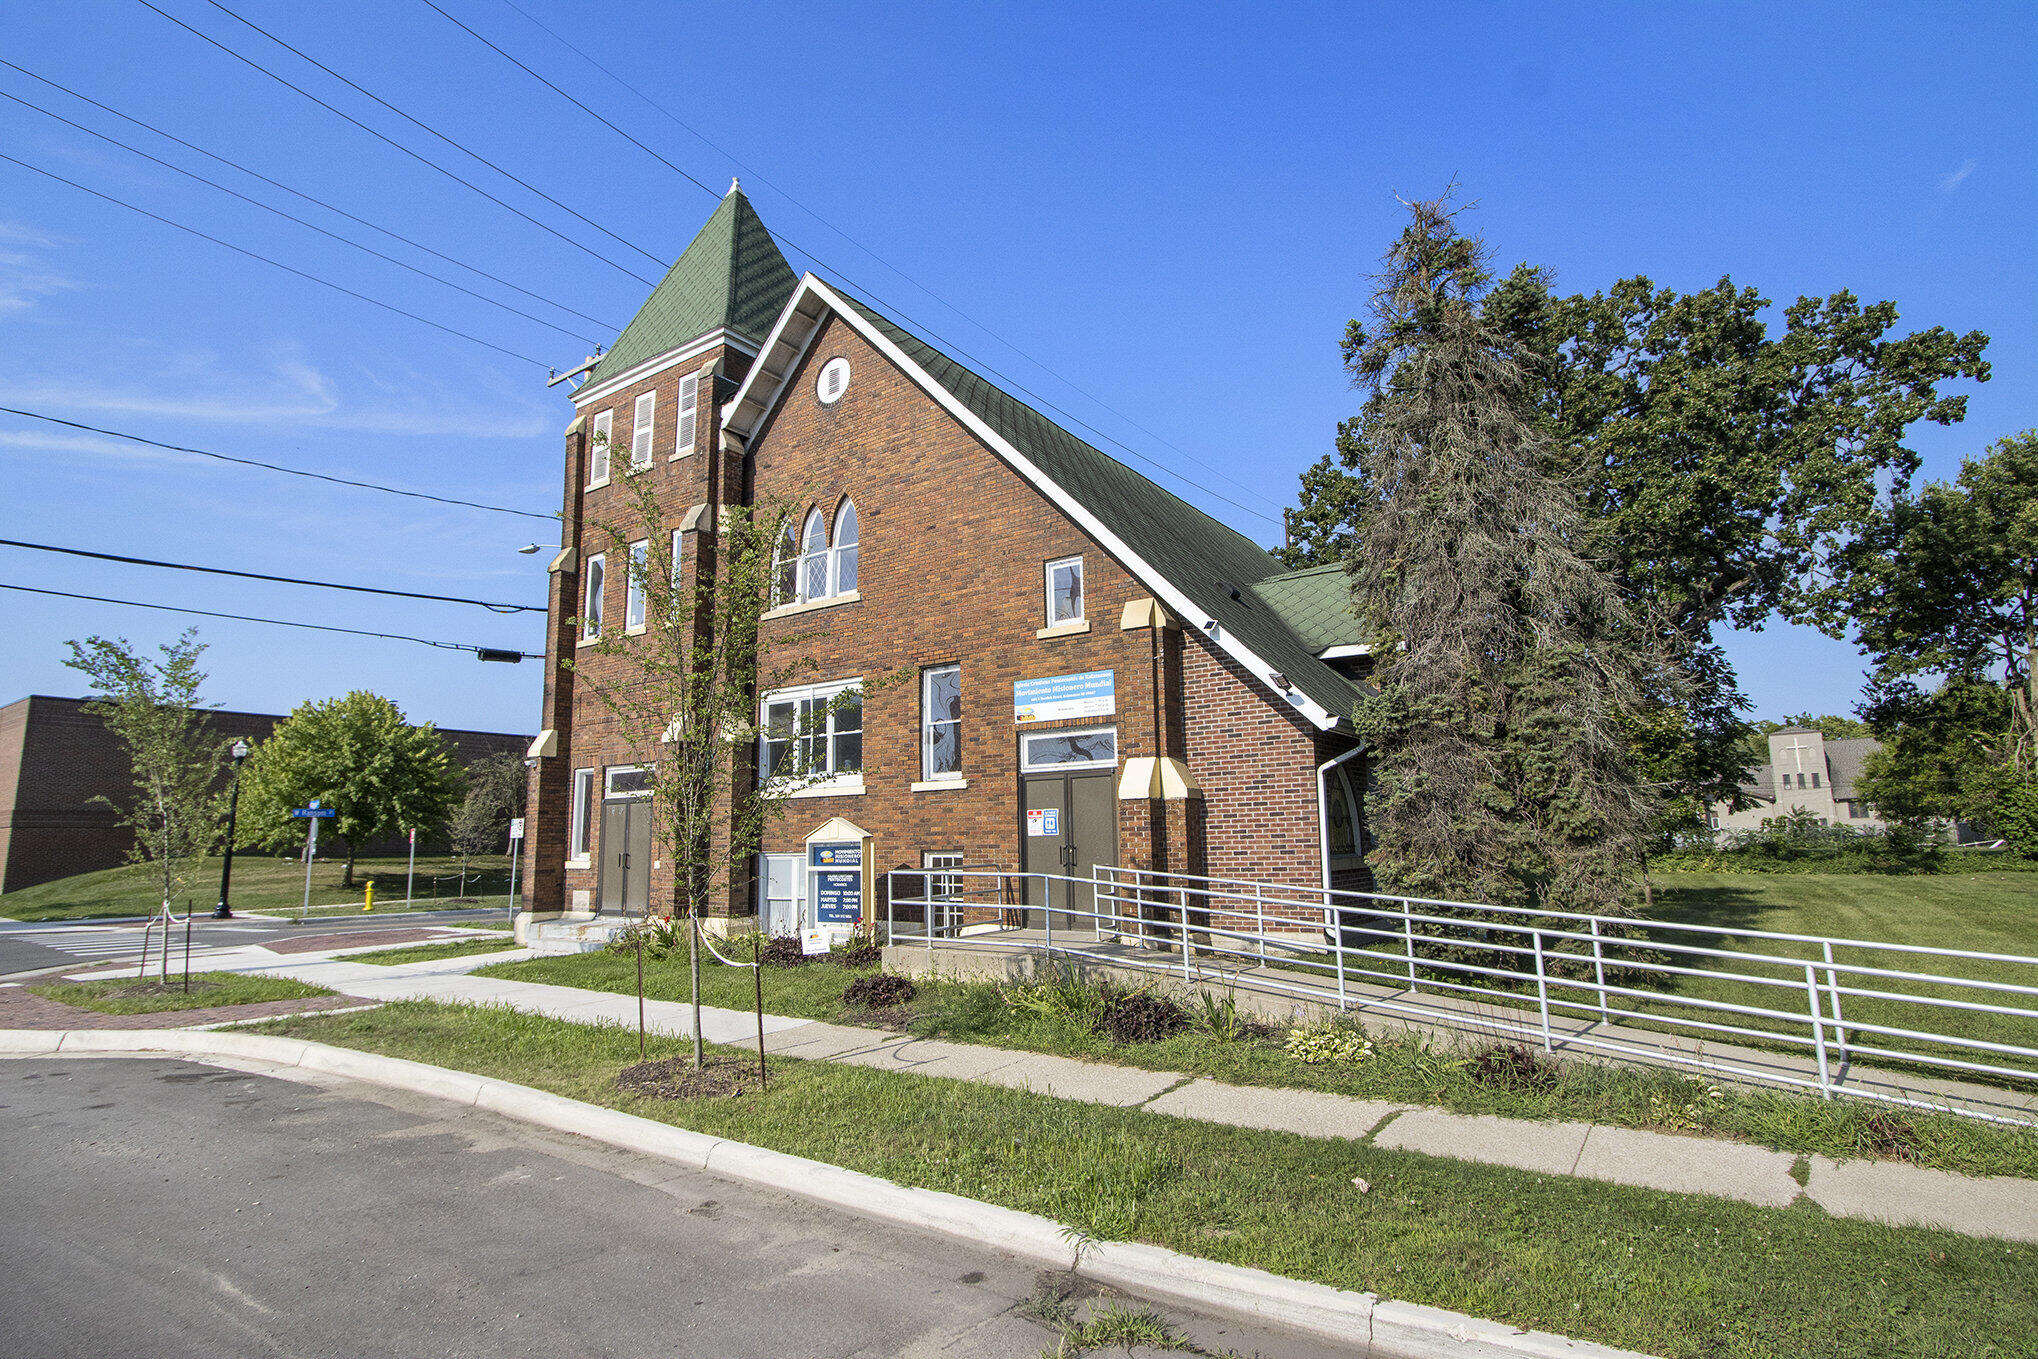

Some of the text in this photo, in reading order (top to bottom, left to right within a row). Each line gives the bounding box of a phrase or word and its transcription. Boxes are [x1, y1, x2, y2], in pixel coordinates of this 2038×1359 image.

[1016, 679, 1112, 696] Movimiento Misionero Mundial
